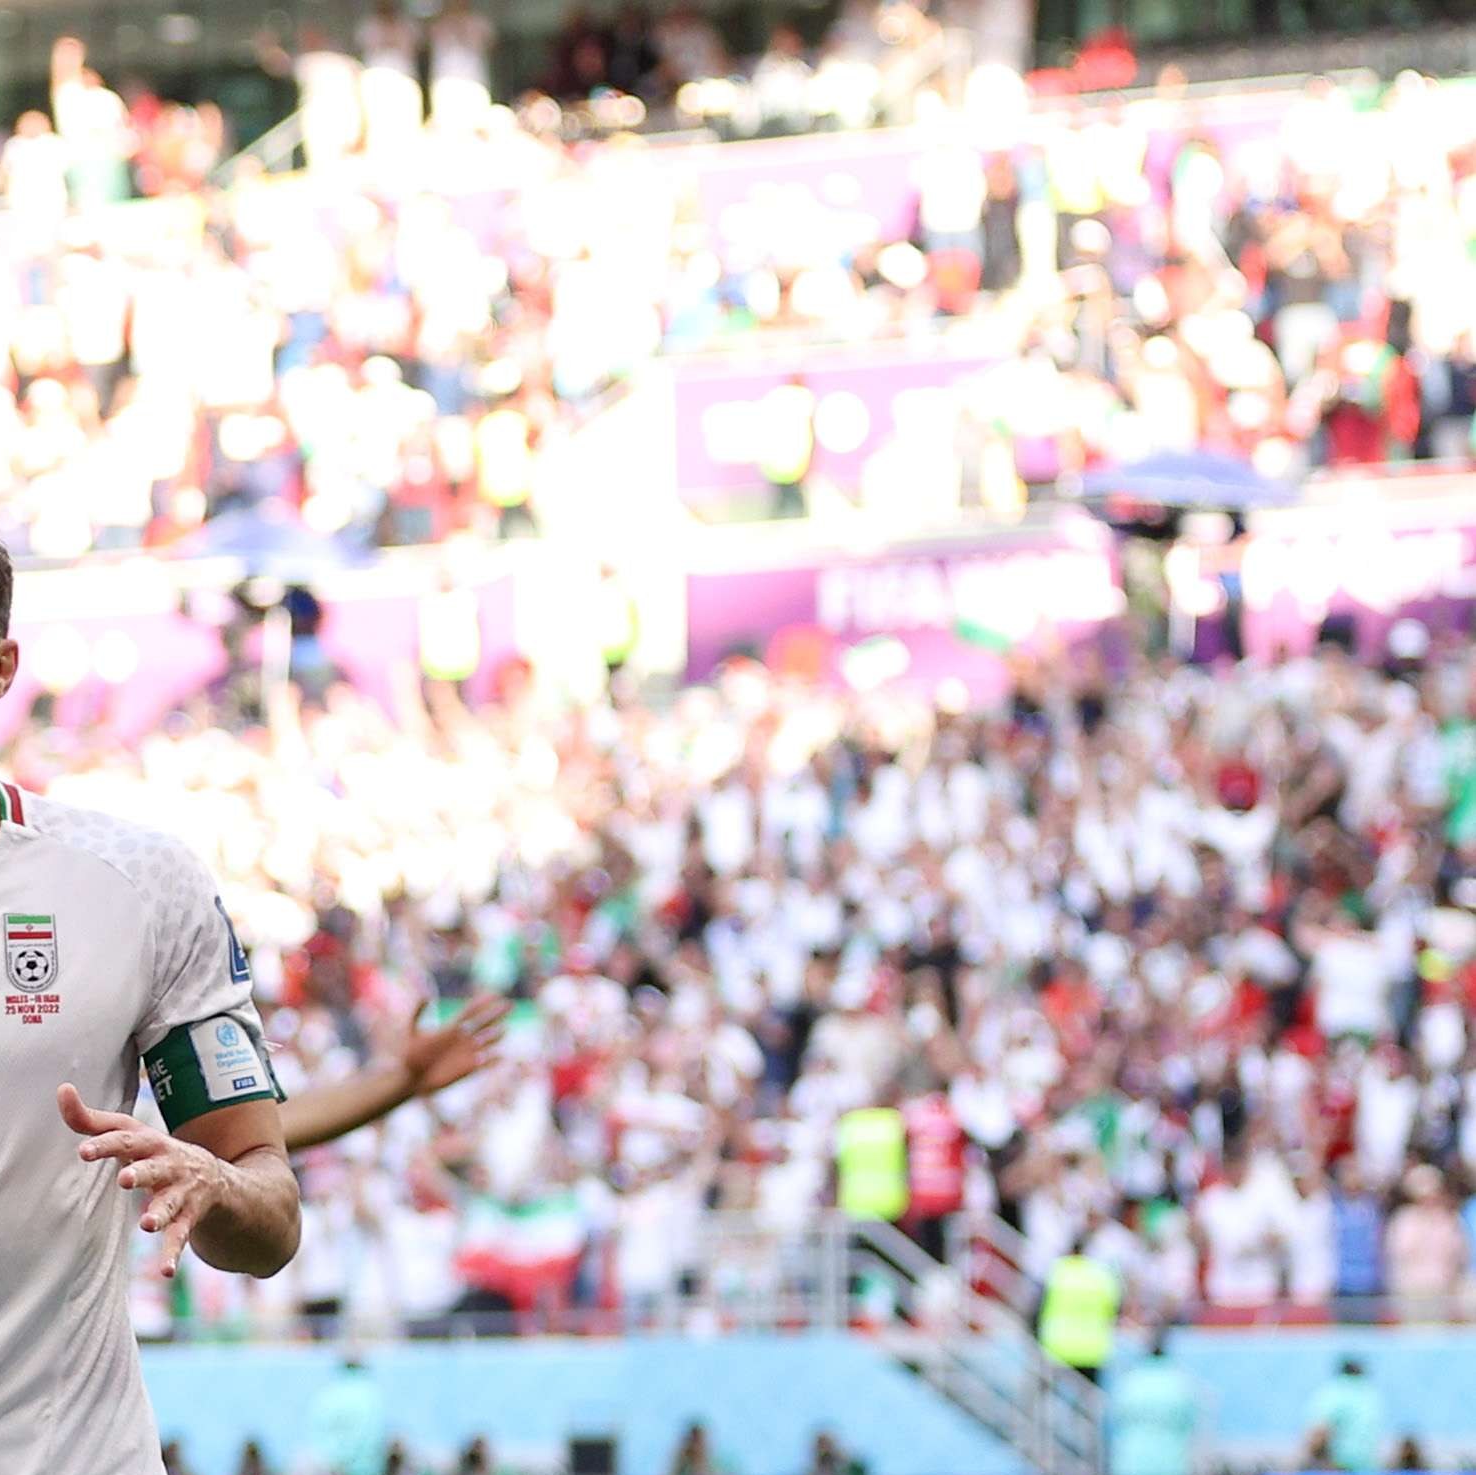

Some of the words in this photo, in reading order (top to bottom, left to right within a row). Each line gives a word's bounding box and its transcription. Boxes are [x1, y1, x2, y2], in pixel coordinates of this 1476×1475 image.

[5, 1005, 17, 1015] 25
[18, 1004, 35, 1014] NOV
[37, 1004, 59, 1014] 2022
